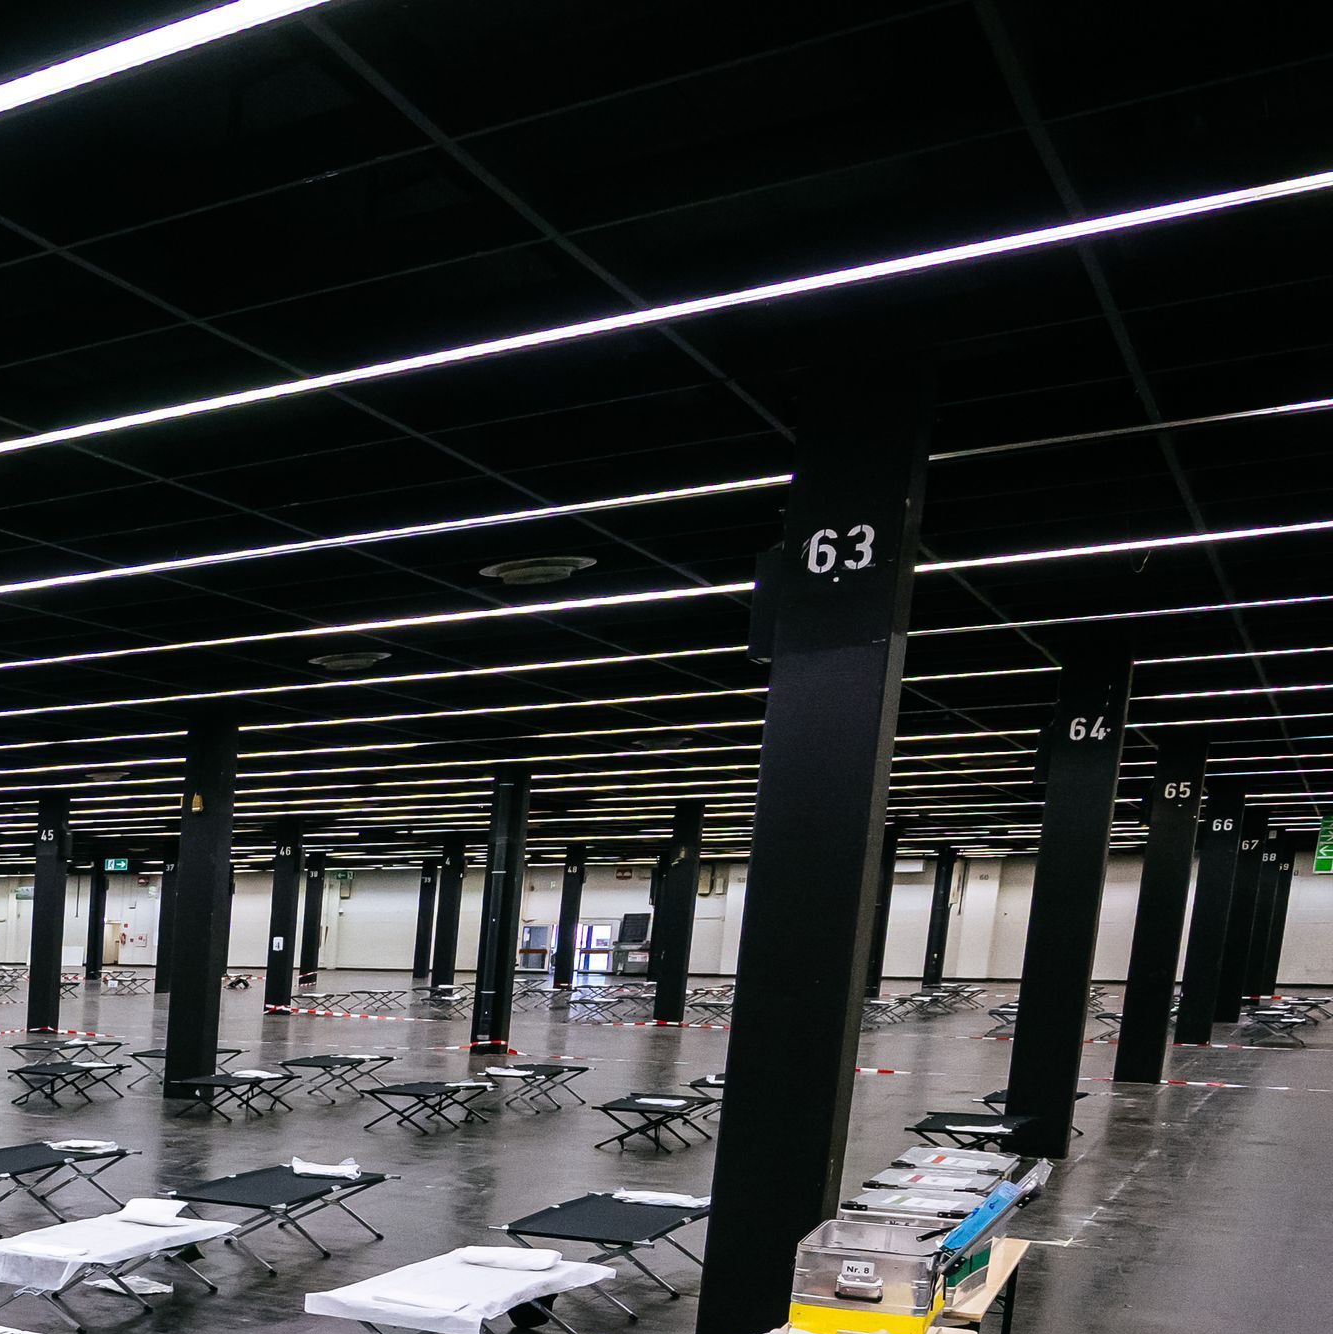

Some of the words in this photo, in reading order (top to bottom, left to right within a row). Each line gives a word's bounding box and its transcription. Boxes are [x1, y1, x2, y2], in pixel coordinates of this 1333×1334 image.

[806, 524, 875, 575] 63
[1068, 716, 1107, 742] 64
[1164, 781, 1191, 799] 65
[1212, 818, 1234, 832] 66
[40, 829, 54, 841] 45
[1241, 839, 1259, 850] 67
[279, 846, 291, 856] 46
[165, 863, 175, 872] 37
[846, 1265, 861, 1274] Nr.
[863, 1267, 870, 1275] 8
